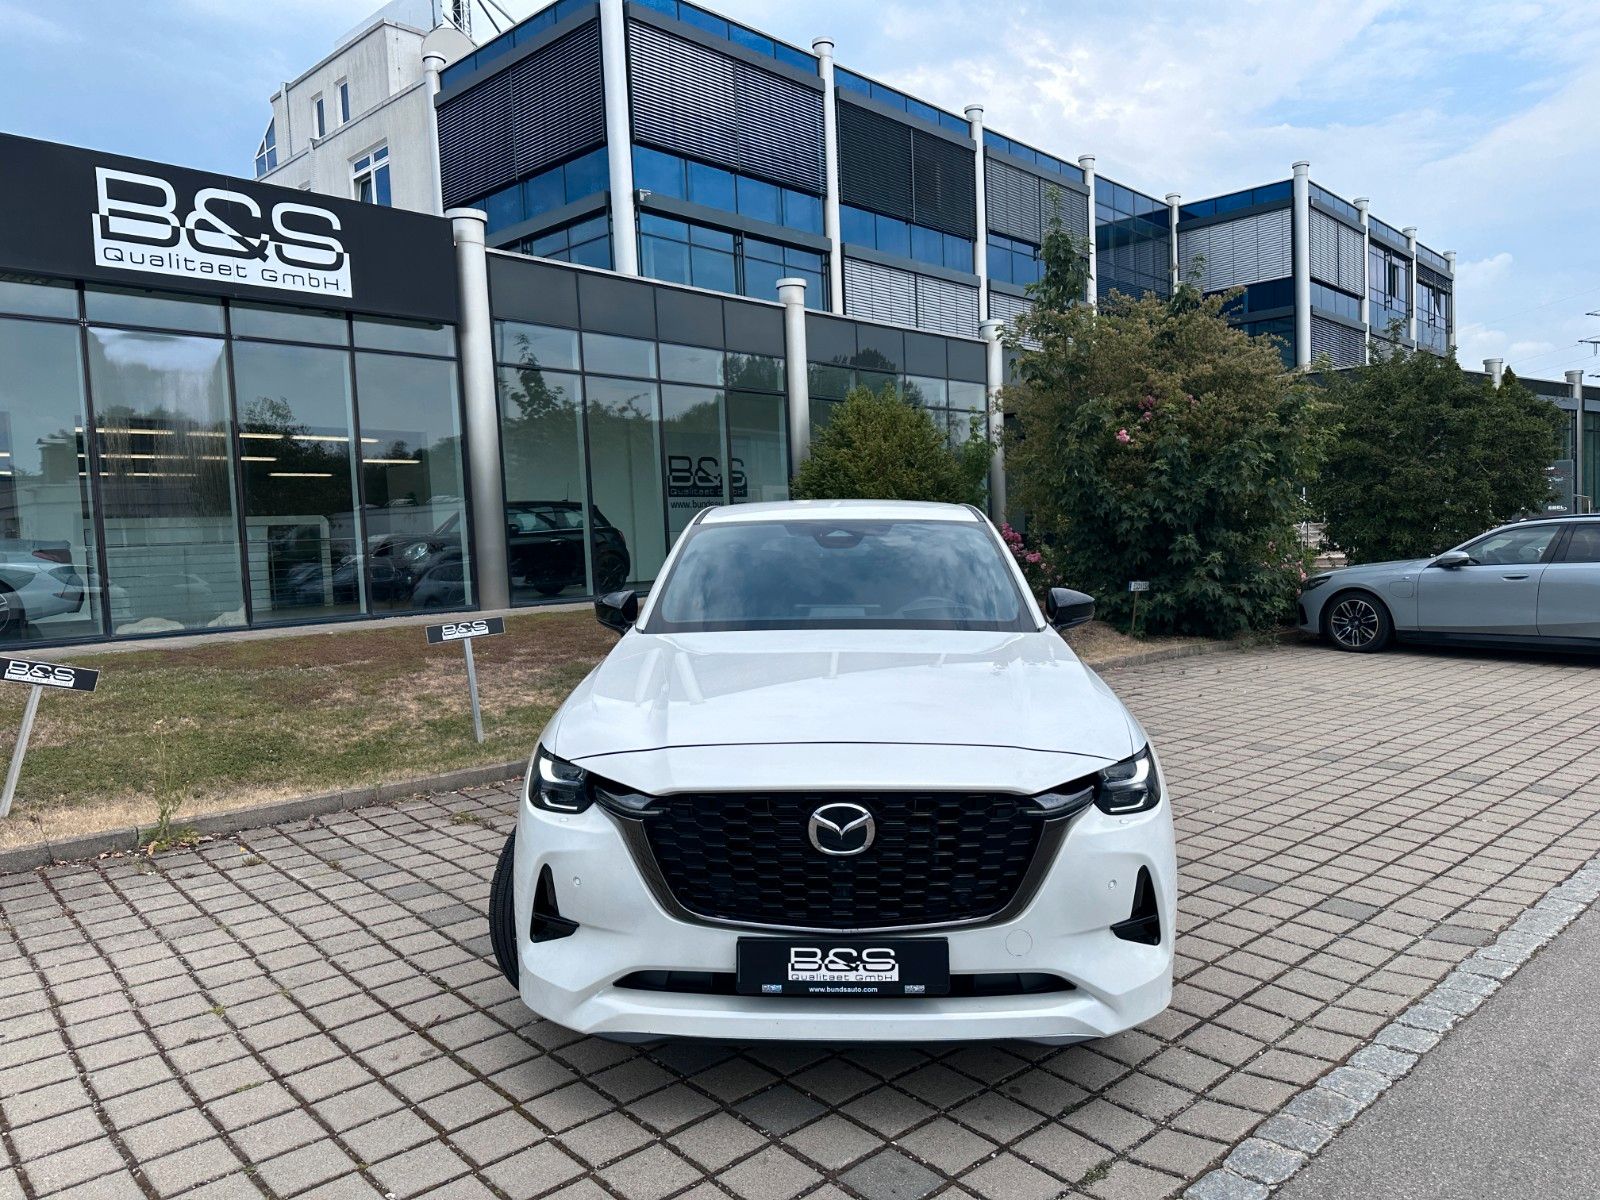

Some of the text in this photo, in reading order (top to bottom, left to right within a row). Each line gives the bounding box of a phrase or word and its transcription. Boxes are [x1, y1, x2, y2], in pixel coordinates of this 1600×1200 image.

[95, 167, 344, 272] B&S
[103, 247, 248, 278] Qualitaet
[668, 456, 746, 487] B&S
[442, 620, 486, 636] B&S
[8, 660, 75, 682] B&S
[790, 947, 896, 973] B&S
[791, 973, 850, 981] Qualitaet
[808, 985, 878, 993] www.bundsauto.com
